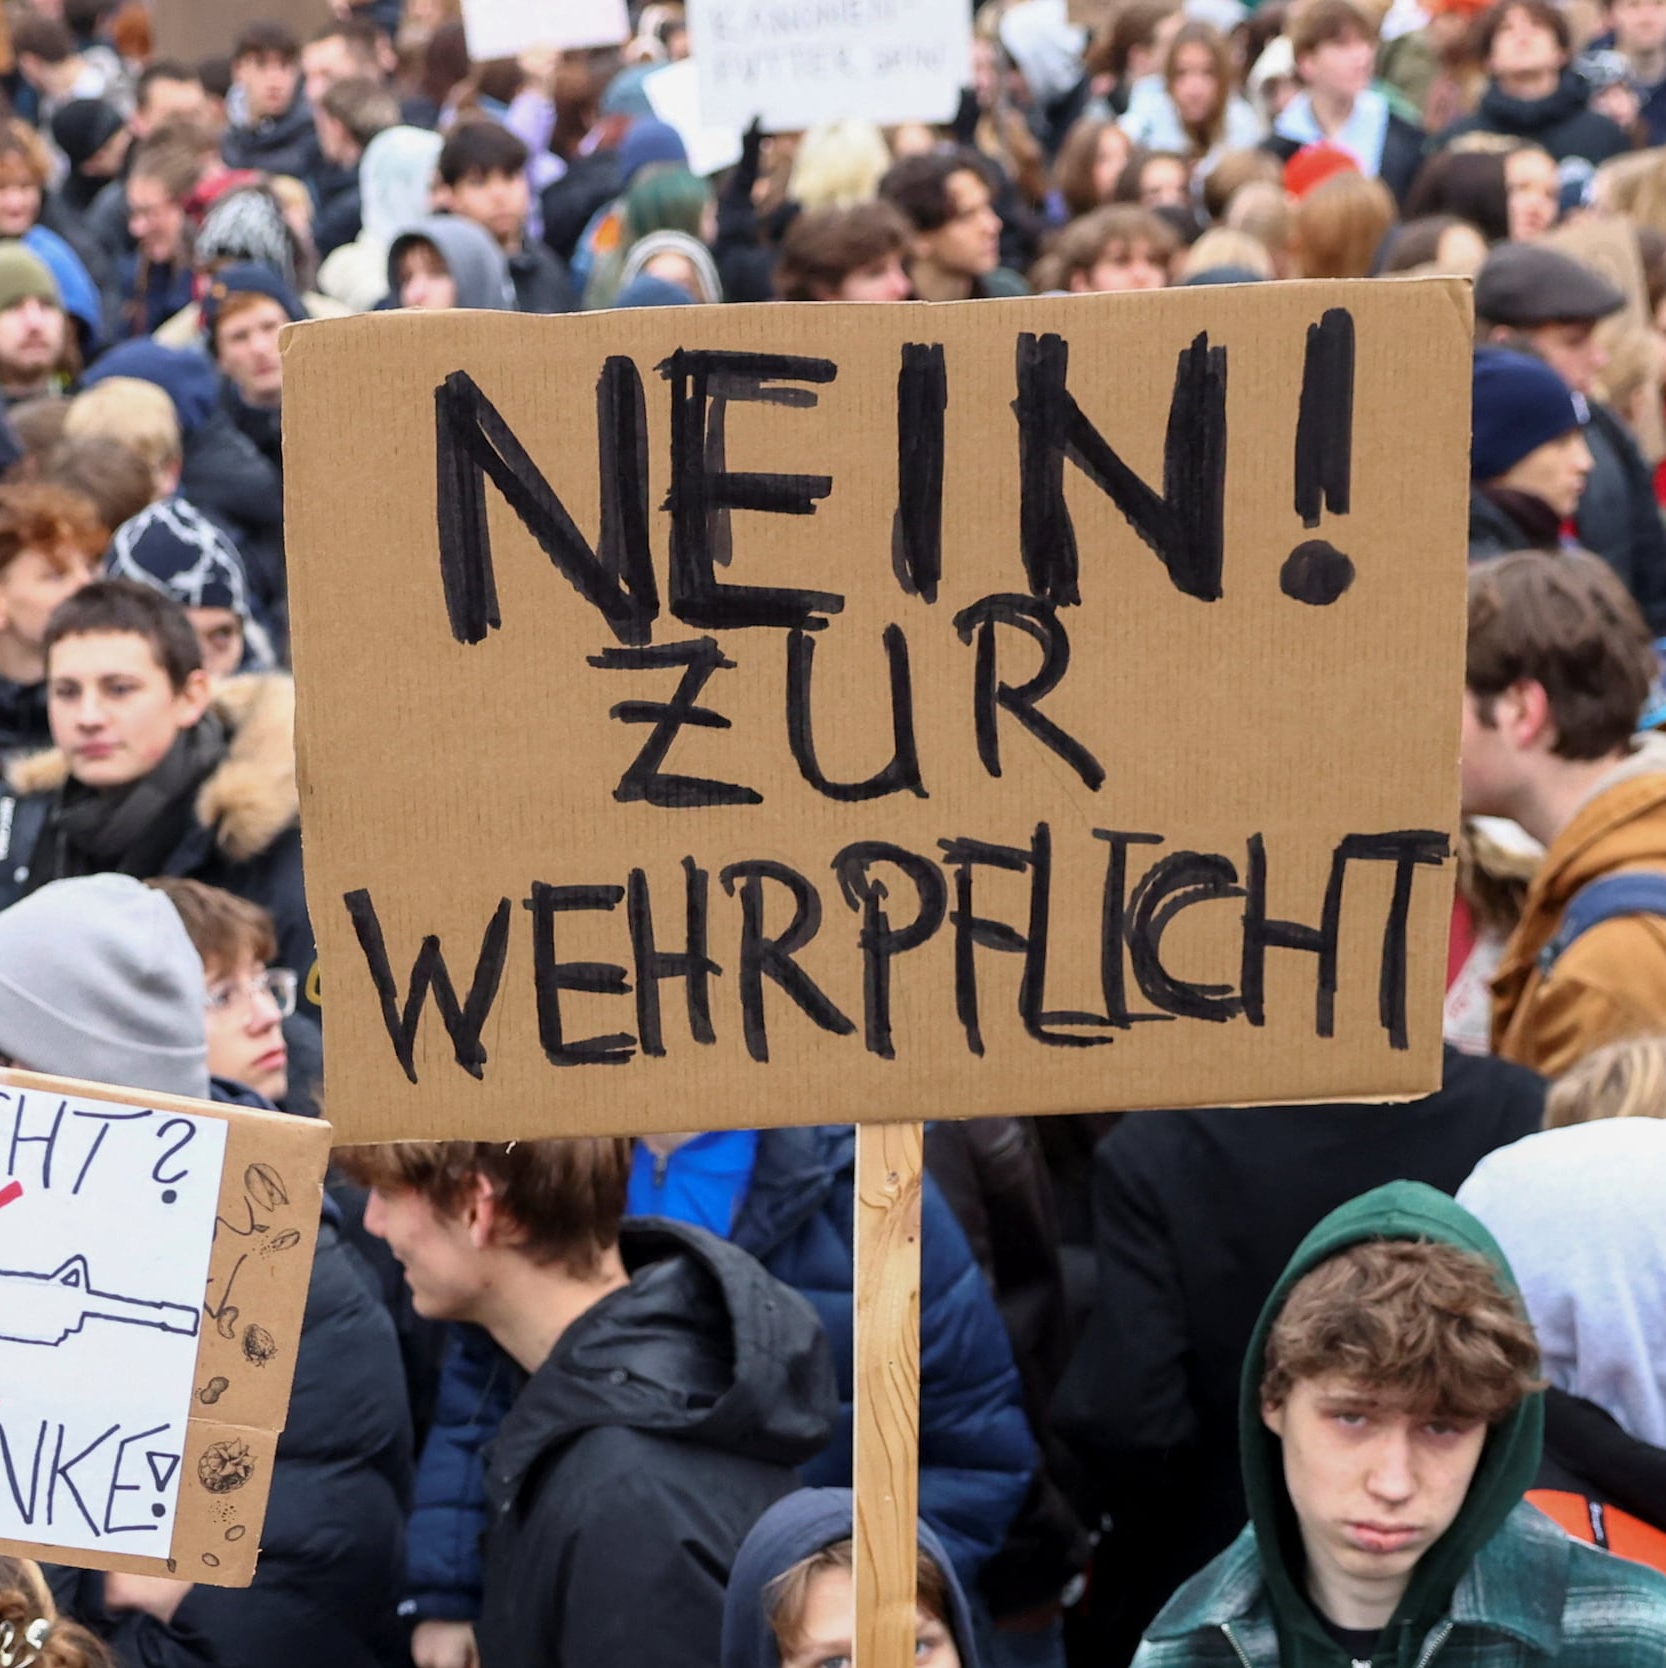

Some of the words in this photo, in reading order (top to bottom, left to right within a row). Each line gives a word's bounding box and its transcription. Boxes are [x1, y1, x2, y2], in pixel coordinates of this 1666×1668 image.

[434, 306, 1356, 646] NEIN!
[586, 593, 1106, 809] ZUR
[342, 821, 1450, 1085] WEHRPFLICHT
